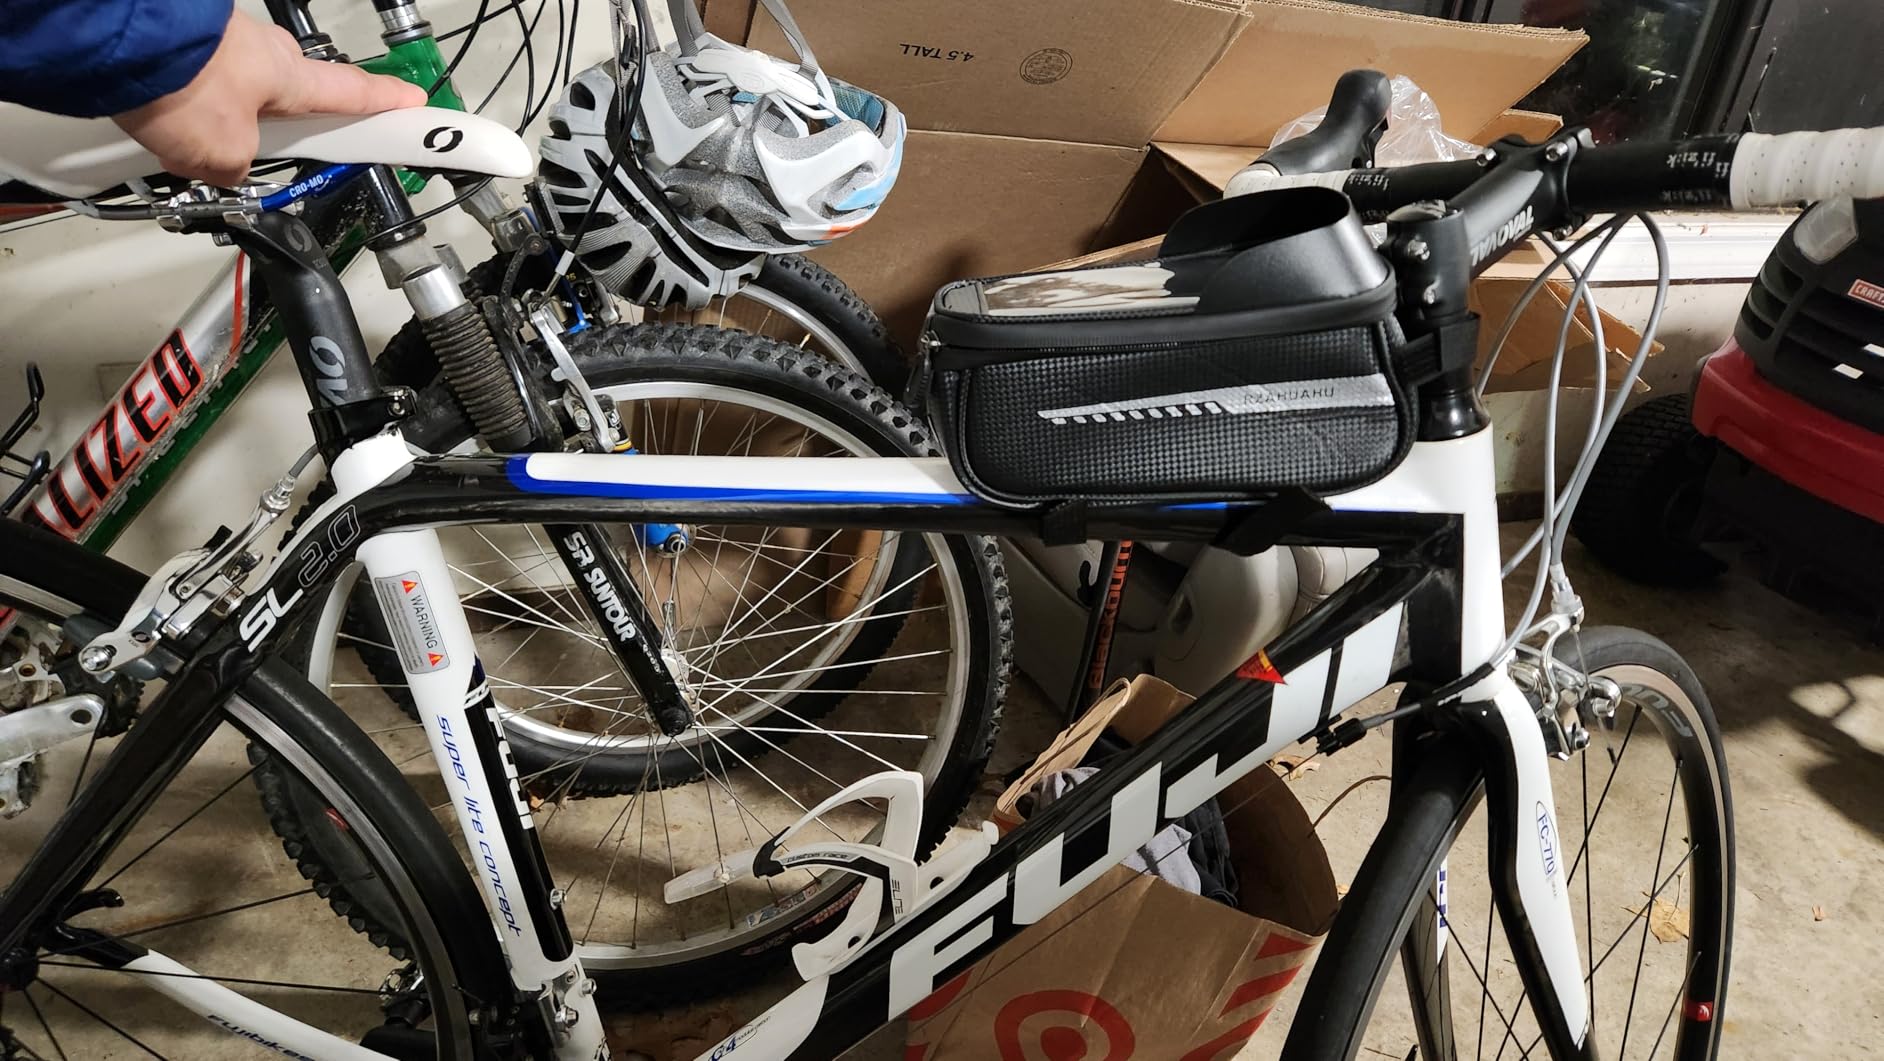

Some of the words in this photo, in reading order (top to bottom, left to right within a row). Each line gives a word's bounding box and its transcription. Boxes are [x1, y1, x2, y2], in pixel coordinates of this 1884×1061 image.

[899, 43, 942, 59] TALL
[946, 49, 974, 62] 4.5
[289, 174, 324, 198] CRO-MO
[22, 327, 205, 540] LIZED
[239, 587, 304, 653] SL
[298, 504, 361, 588] 2.0
[563, 531, 595, 568] SR
[584, 567, 636, 642] SUNTOUR
[410, 594, 438, 649] WARNING
[437, 714, 470, 791] super
[463, 796, 485, 834] lite
[478, 840, 522, 937] concept
